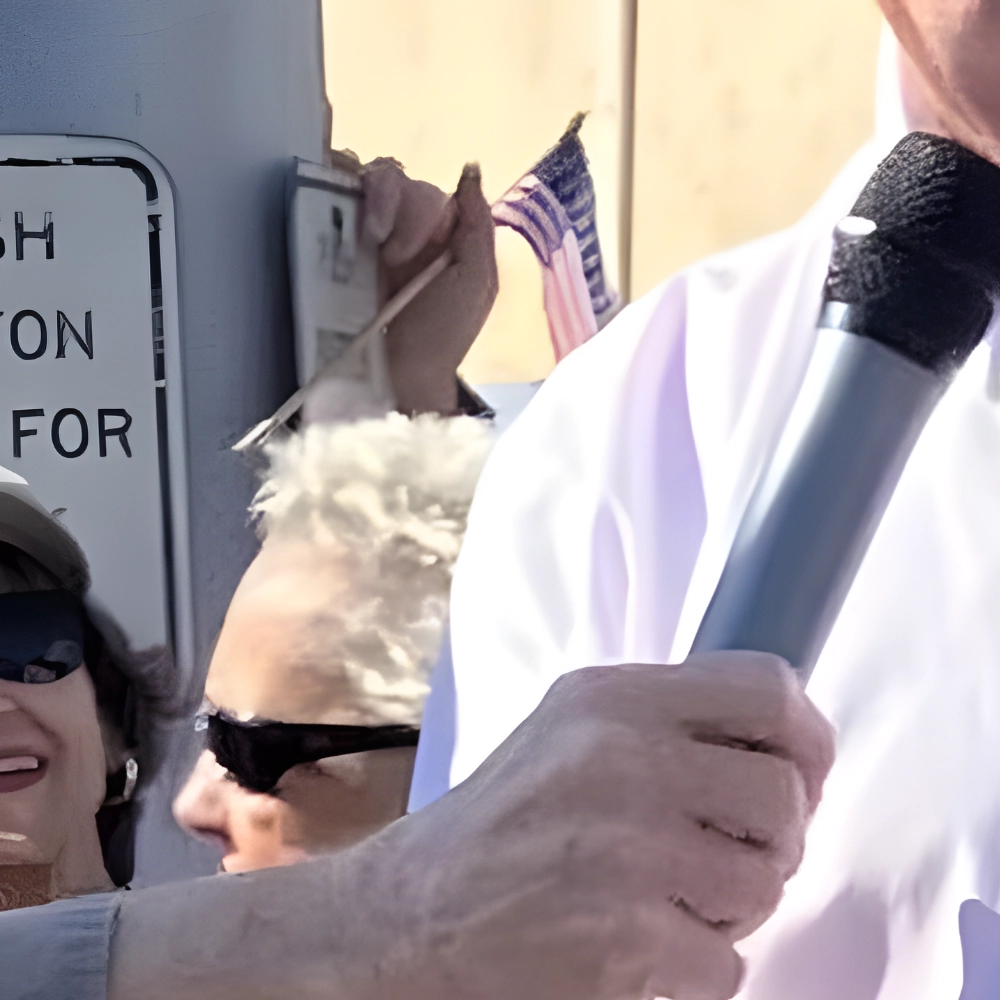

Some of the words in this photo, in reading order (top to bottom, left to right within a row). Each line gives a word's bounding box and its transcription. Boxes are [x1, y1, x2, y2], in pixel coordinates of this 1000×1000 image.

[0, 211, 54, 260] H
[0, 307, 94, 360] ON
[12, 407, 133, 458] FOR
